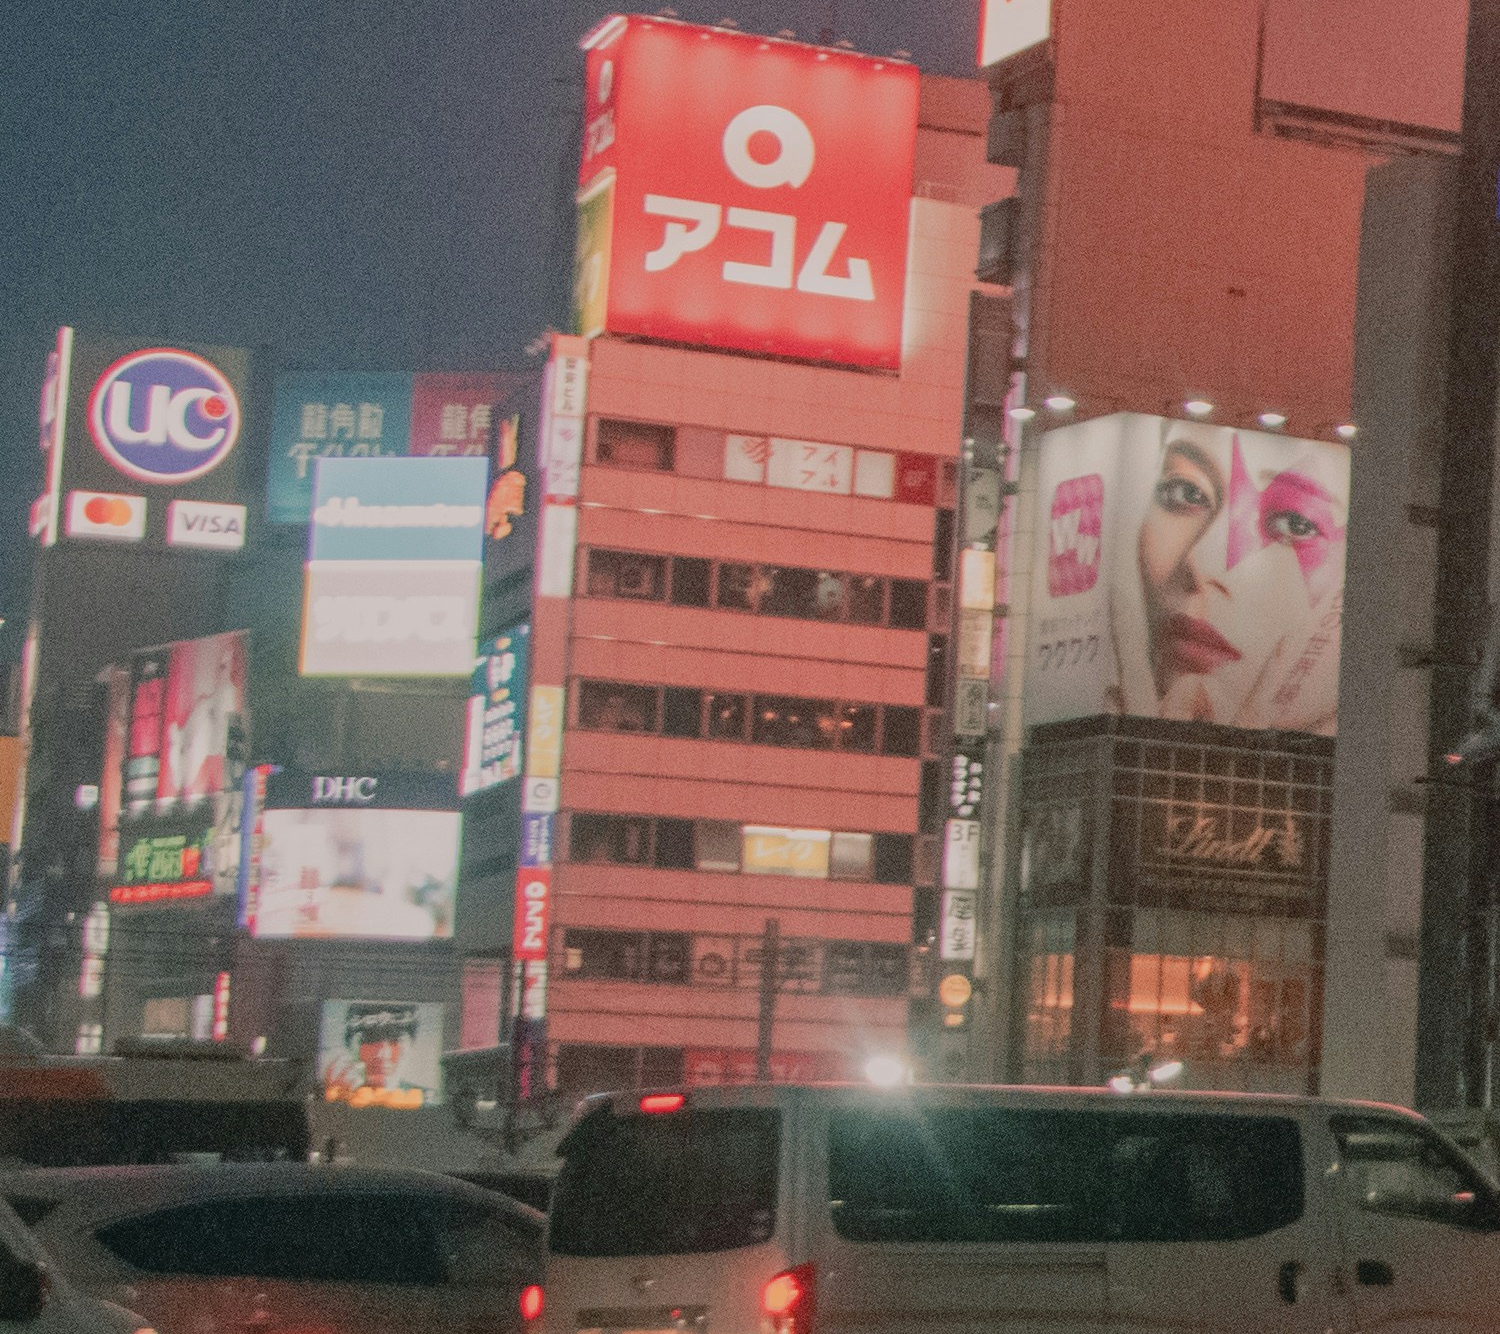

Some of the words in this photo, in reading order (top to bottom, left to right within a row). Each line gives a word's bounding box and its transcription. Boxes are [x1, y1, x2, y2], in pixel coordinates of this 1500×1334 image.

[643, 193, 877, 302] アコム
[107, 379, 231, 451] UC
[180, 510, 242, 536] VISA
[312, 775, 379, 804] DHC
